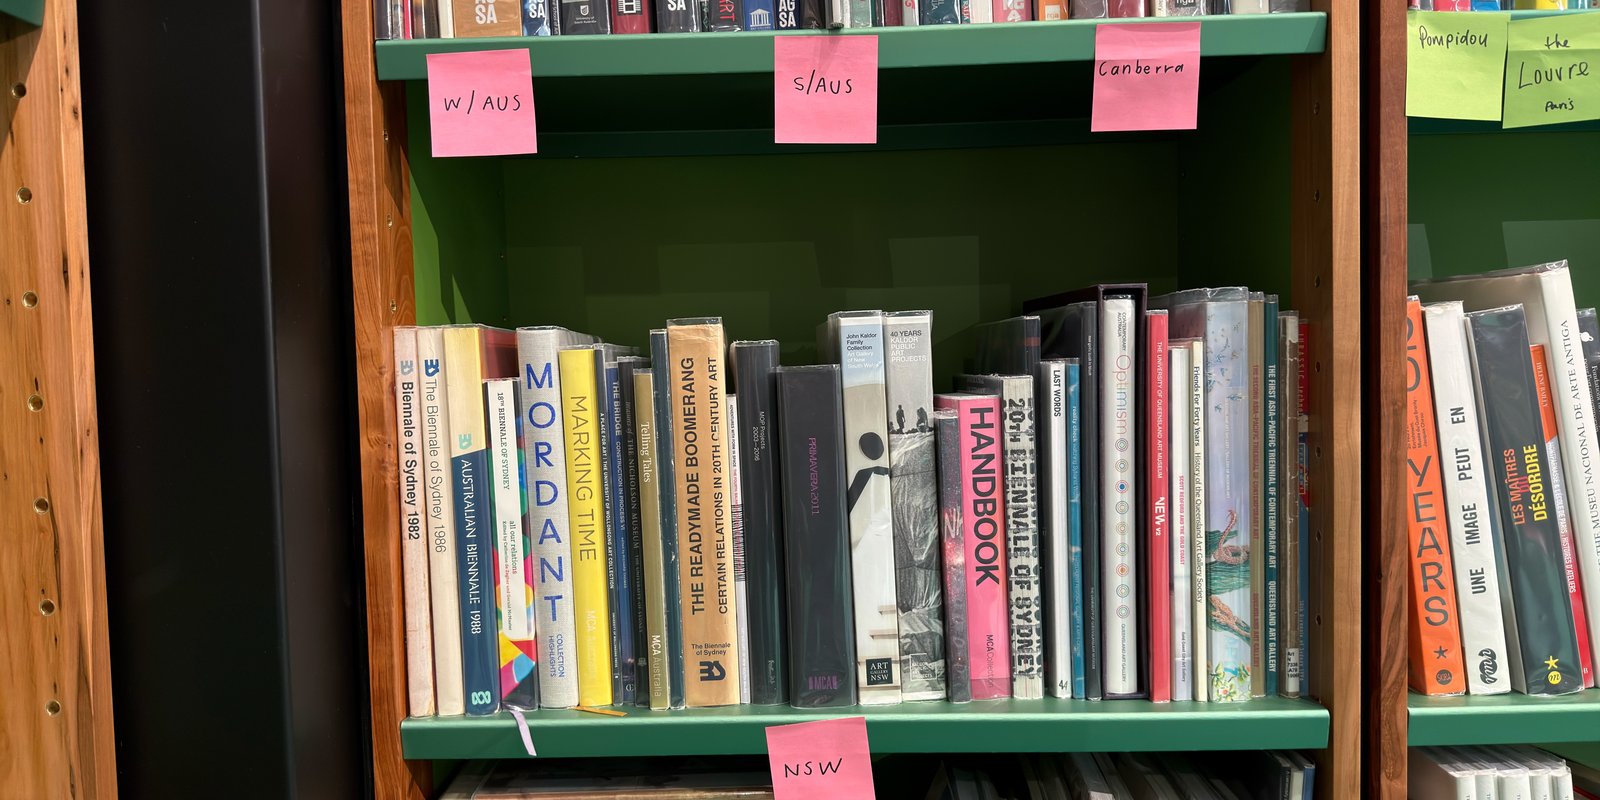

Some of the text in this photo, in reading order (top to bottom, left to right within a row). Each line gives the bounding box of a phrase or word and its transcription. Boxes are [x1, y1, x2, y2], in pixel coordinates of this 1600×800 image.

[475, 4, 498, 24] SA
[529, 4, 546, 19] SA
[668, 0, 686, 11] SA
[780, 12, 796, 28] SA
[1418, 25, 1488, 49] Pompidou
[1544, 33, 1571, 49] the
[793, 69, 852, 95] S/AUS
[1099, 59, 1184, 76] Canberra
[1518, 61, 1589, 89] Louvre
[1561, 319, 1574, 365] ANTIGA
[1053, 389, 1062, 417] WORDS
[1112, 355, 1132, 434] Optimism
[1157, 390, 1162, 398] OF
[1569, 369, 1581, 399] ARTE
[1193, 407, 1201, 426] Forty
[1574, 402, 1584, 419] DE
[402, 382, 420, 540] Biennale of Sydney 1982
[425, 380, 446, 553] The Biennale of Sydney 1986
[498, 408, 510, 490] BIENNALE OF SYDNEY
[616, 442, 624, 486] CONSTRUCTION
[640, 422, 652, 482] Telling Tales
[1194, 453, 1202, 479] History
[1578, 423, 1595, 484] NACIONAL
[526, 362, 564, 622] MORDANT
[571, 396, 596, 561] MARKING TIME
[628, 459, 638, 509] NICHOLSON
[681, 358, 705, 615] THE READYMADE BOOMERANG
[708, 357, 728, 614] CERTAIN RELATIONS IN 20TH CENTURY ART
[808, 438, 820, 515] PRIMAVERA 2011
[1269, 487, 1276, 496] OF
[1504, 448, 1525, 525] LES MAÎTRES
[1523, 444, 1547, 521] DÉSORDRE
[970, 407, 999, 587] HANDBOOK
[1155, 497, 1165, 526] NEW
[1450, 406, 1487, 595] UNE IMAGE PEUT EN
[1586, 488, 1600, 530] MUSEU
[631, 513, 639, 549] MUSEUM
[1195, 498, 1203, 538] Queensland
[1558, 518, 1567, 533] PARIS
[461, 460, 481, 634] AUSTRALIAN BIENNALE 1988
[1009, 398, 1034, 679] 20TH BIENNALE OF SYDNEY
[1407, 455, 1449, 626] YEARS
[1561, 537, 1571, 564] HISTOIRES
[1195, 553, 1204, 577] Gallery
[1565, 565, 1576, 593] D'ATELIERS
[1195, 578, 1204, 604] Society
[556, 634, 564, 678] COLLECTION
[986, 634, 994, 652] MCA
[652, 635, 662, 697] MCA Australia
[785, 758, 842, 778] NSW
